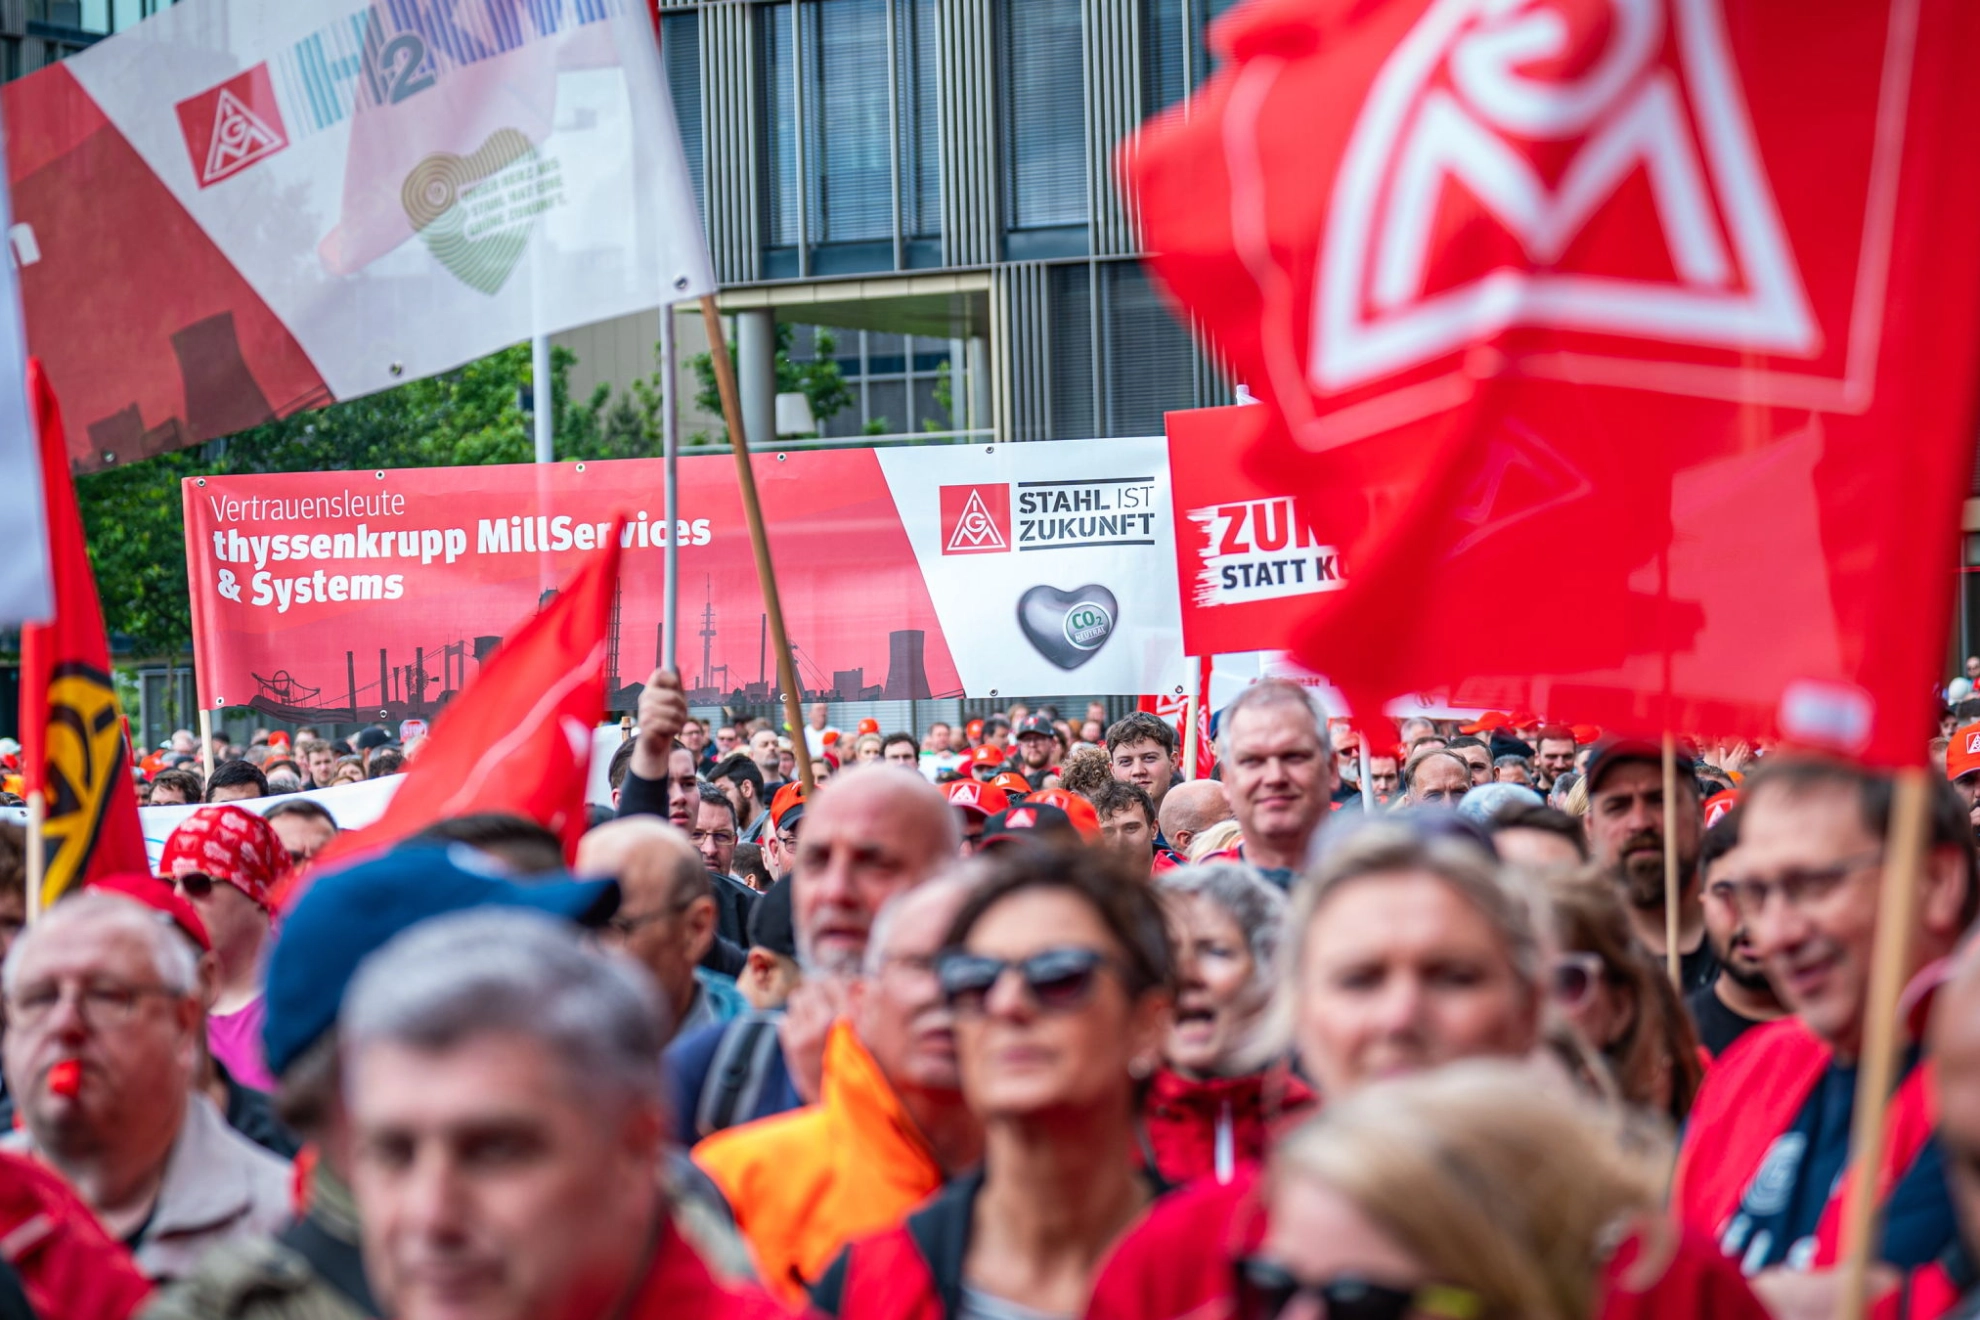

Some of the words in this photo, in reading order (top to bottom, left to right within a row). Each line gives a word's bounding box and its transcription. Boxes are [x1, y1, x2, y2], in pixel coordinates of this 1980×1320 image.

[210, 489, 405, 522] Vertrauensleute
[1018, 489, 1111, 514] STAHL
[1117, 486, 1155, 509] IST
[1019, 512, 1155, 542] ZUKUNFT
[213, 523, 467, 571] thyssenkrupp
[1221, 557, 1307, 590] STATT
[217, 568, 242, 603] &
[251, 570, 404, 614] Systems
[1075, 626, 1106, 642] NEUTRAL
